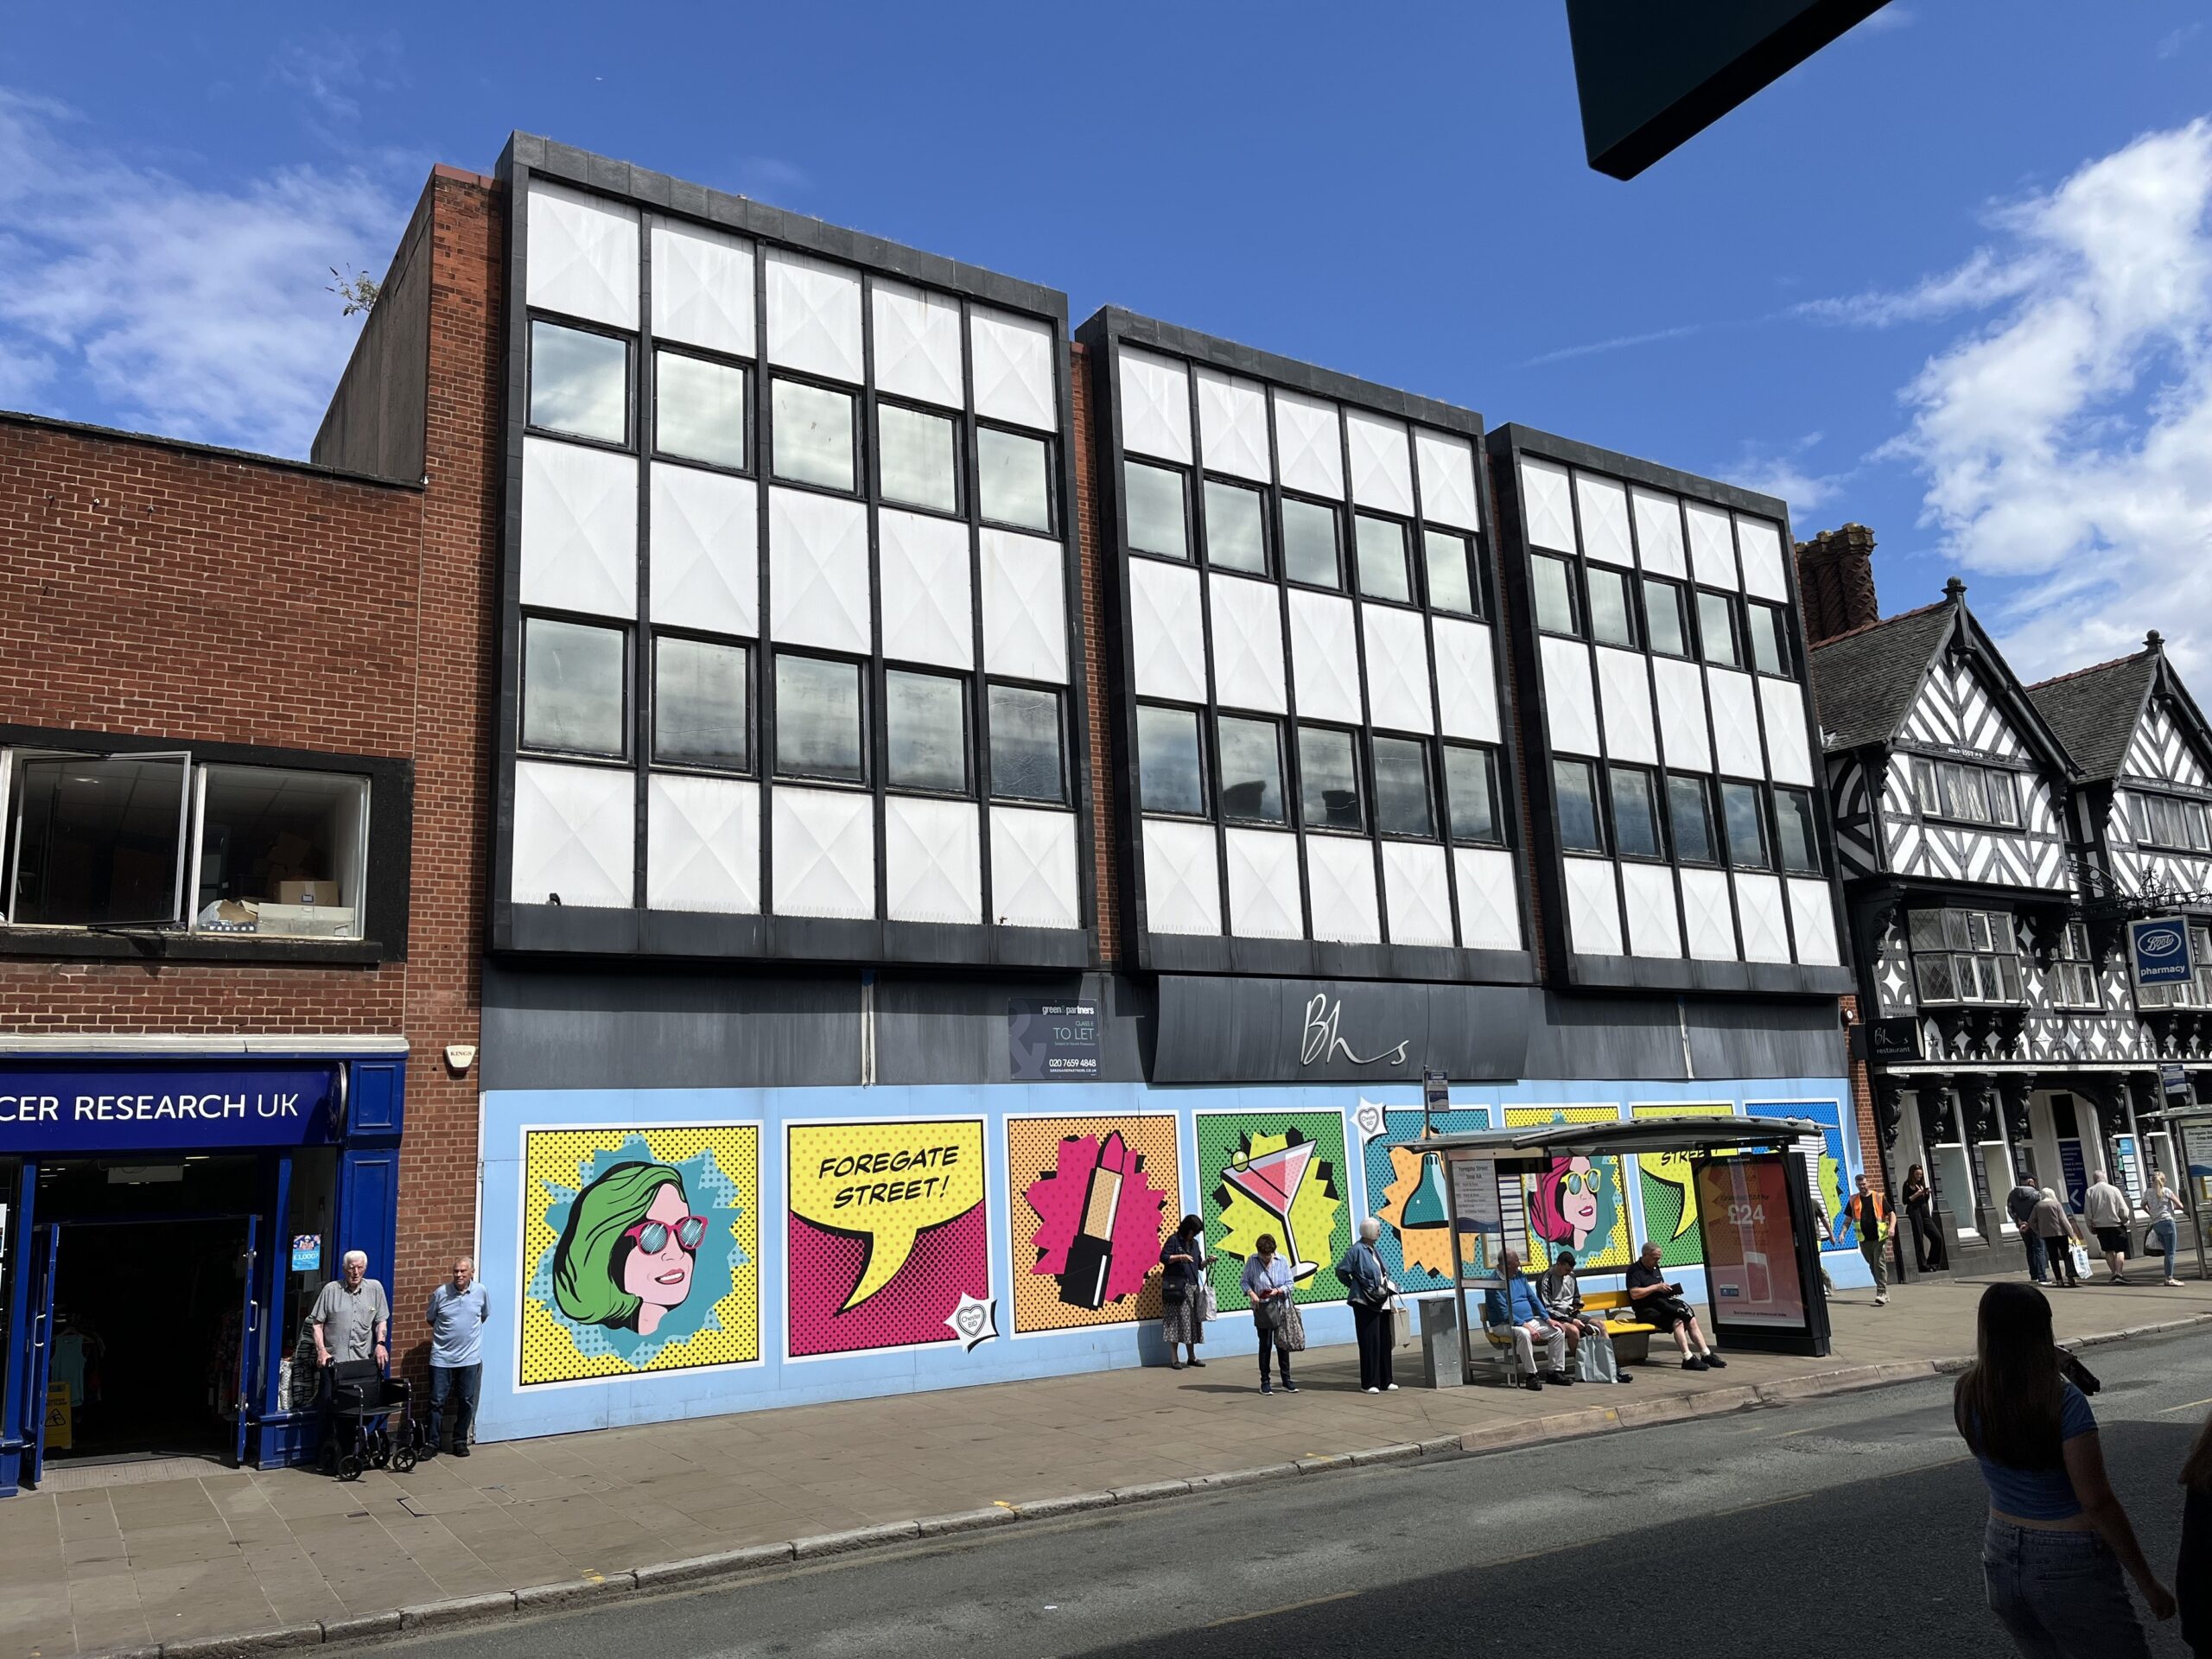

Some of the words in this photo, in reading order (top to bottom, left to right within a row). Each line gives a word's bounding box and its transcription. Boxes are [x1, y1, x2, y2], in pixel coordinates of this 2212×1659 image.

[2145, 934, 2174, 951] Boots
[2140, 965, 2185, 976] pharmacy
[1052, 1027, 1071, 1040] TO
[1074, 1027, 1095, 1040] LET
[1300, 994, 1409, 1065] Bhs
[1874, 1027, 1909, 1046] Bhs
[1049, 1058, 1062, 1067] 020
[1063, 1058, 1079, 1067] 7659
[1080, 1058, 1096, 1067] 4848
[74, 1094, 246, 1121] RESEARCH
[257, 1093, 299, 1117] UK
[818, 1146, 960, 1179] FOREGATE
[833, 1174, 950, 1210] STREET!
[1727, 1204, 1765, 1224] £24
[961, 1313, 981, 1323] Chester
